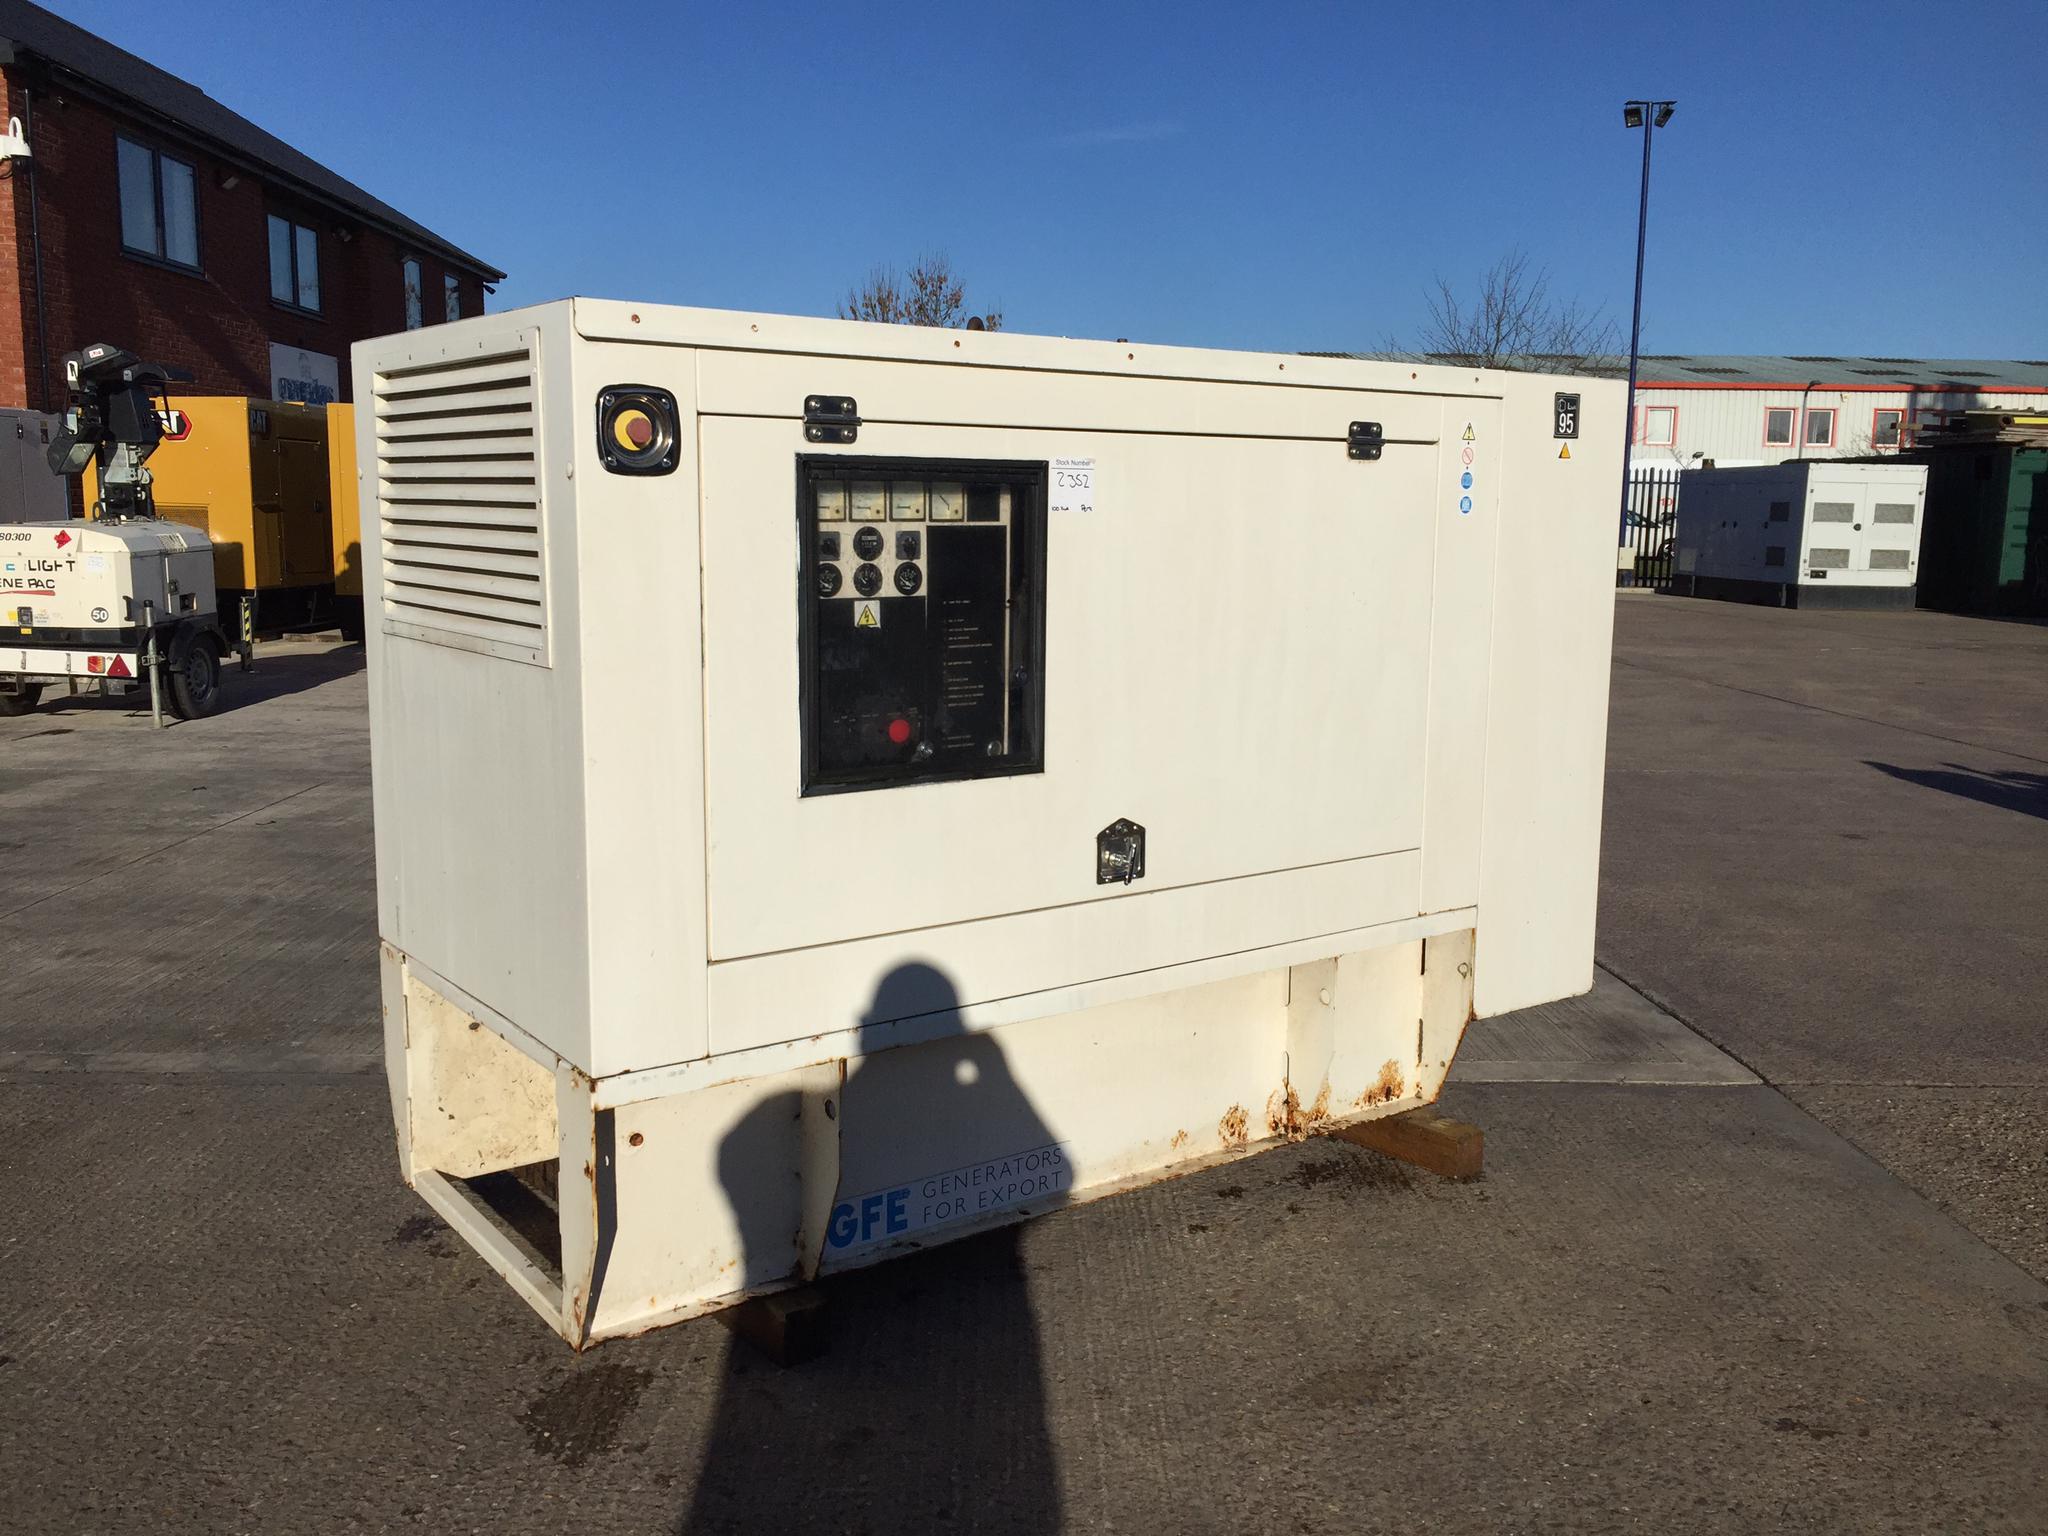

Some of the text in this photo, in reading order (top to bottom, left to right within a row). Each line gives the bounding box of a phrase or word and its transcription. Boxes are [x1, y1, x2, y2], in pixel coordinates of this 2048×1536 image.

[251, 410, 267, 433] CAT
[1559, 413, 1574, 433] 95
[1057, 471, 1090, 489] 2352
[0, 578, 55, 589] NE PAC
[93, 609, 108, 620] 50
[922, 1147, 1062, 1199] GENERATORS
[923, 1170, 1064, 1224] FOR EXPORT
[827, 1188, 910, 1249] GFE
